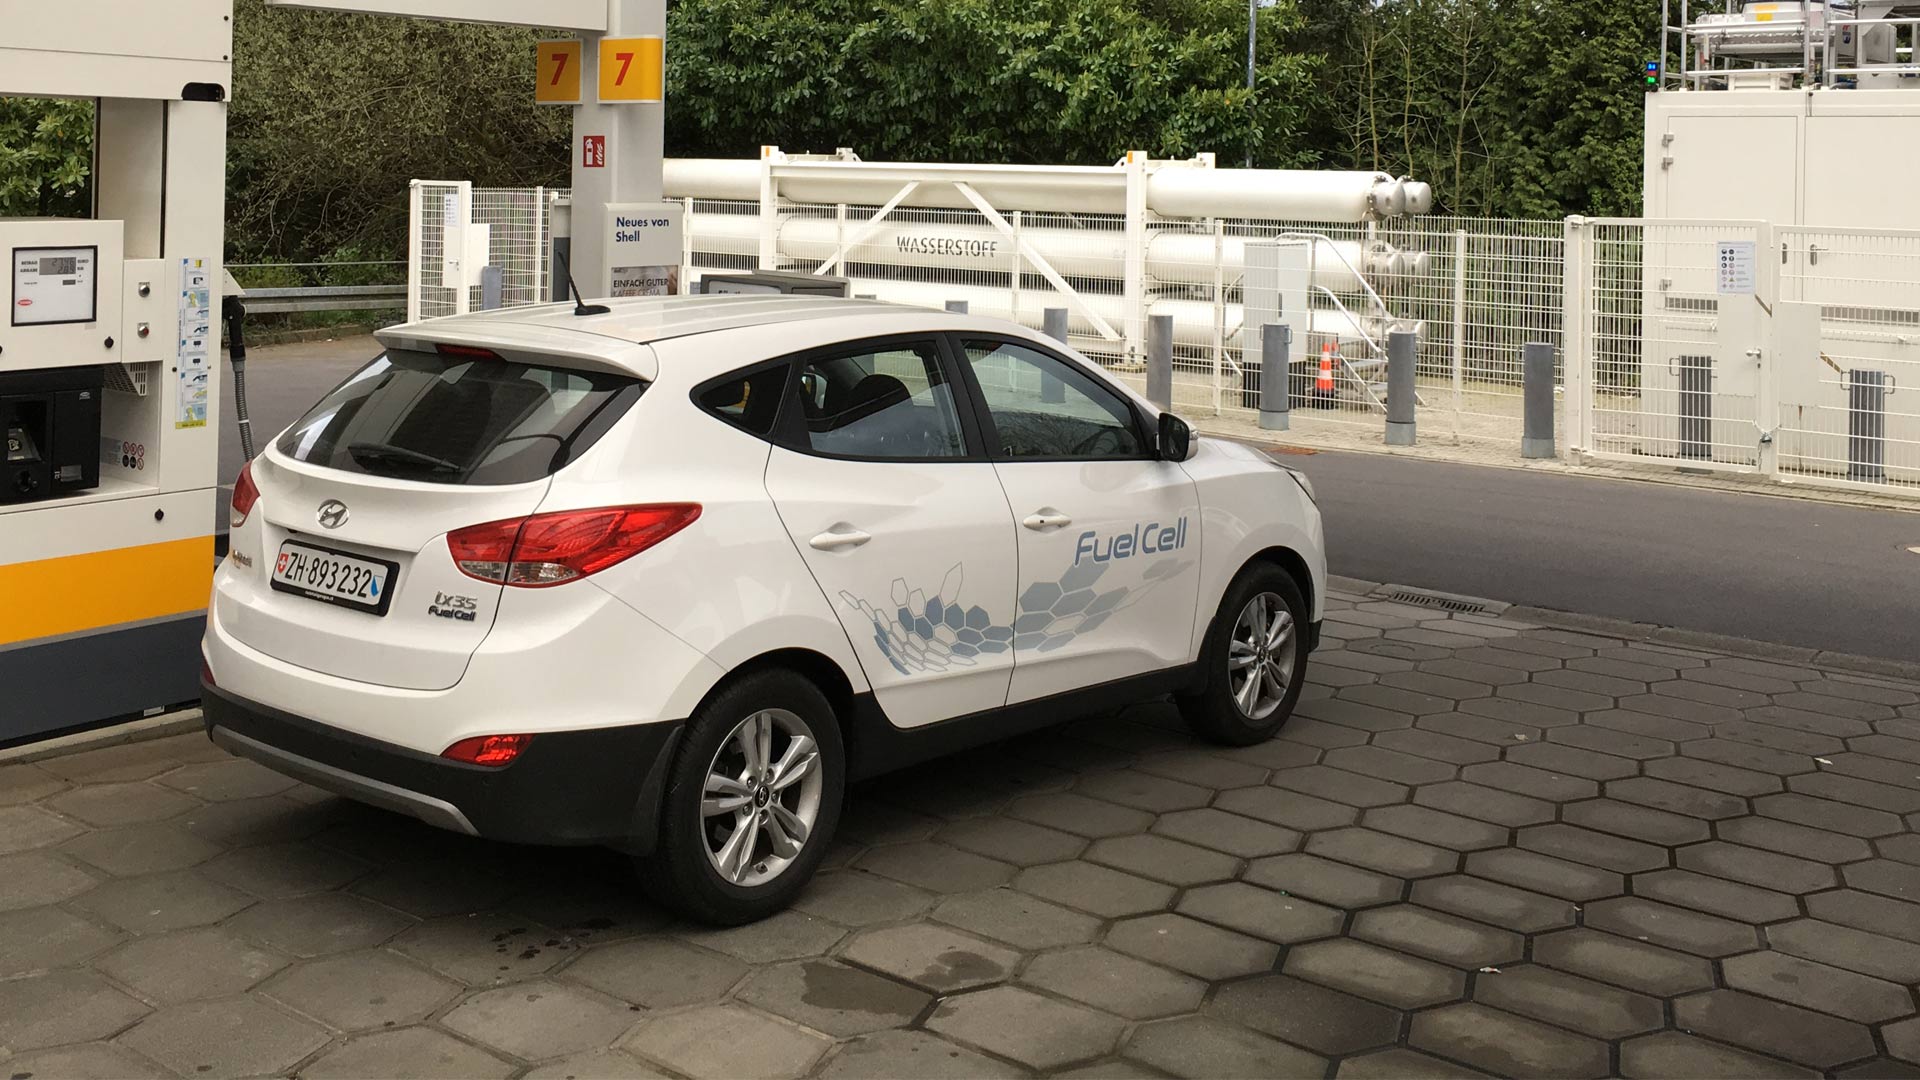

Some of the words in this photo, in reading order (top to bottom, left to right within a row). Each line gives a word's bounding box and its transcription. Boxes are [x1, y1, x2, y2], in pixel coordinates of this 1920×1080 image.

[550, 53, 569, 86] 7
[614, 52, 634, 86] 7
[616, 217, 648, 227] Neues
[651, 219, 669, 227] von
[616, 230, 640, 242] Shell
[897, 236, 998, 257] WASSERSTOFF
[613, 278, 645, 288] EINFACH
[646, 278, 669, 287] GUTER
[1074, 522, 1140, 566] Fuel
[1141, 516, 1188, 554] Cell
[434, 591, 478, 610] ix35
